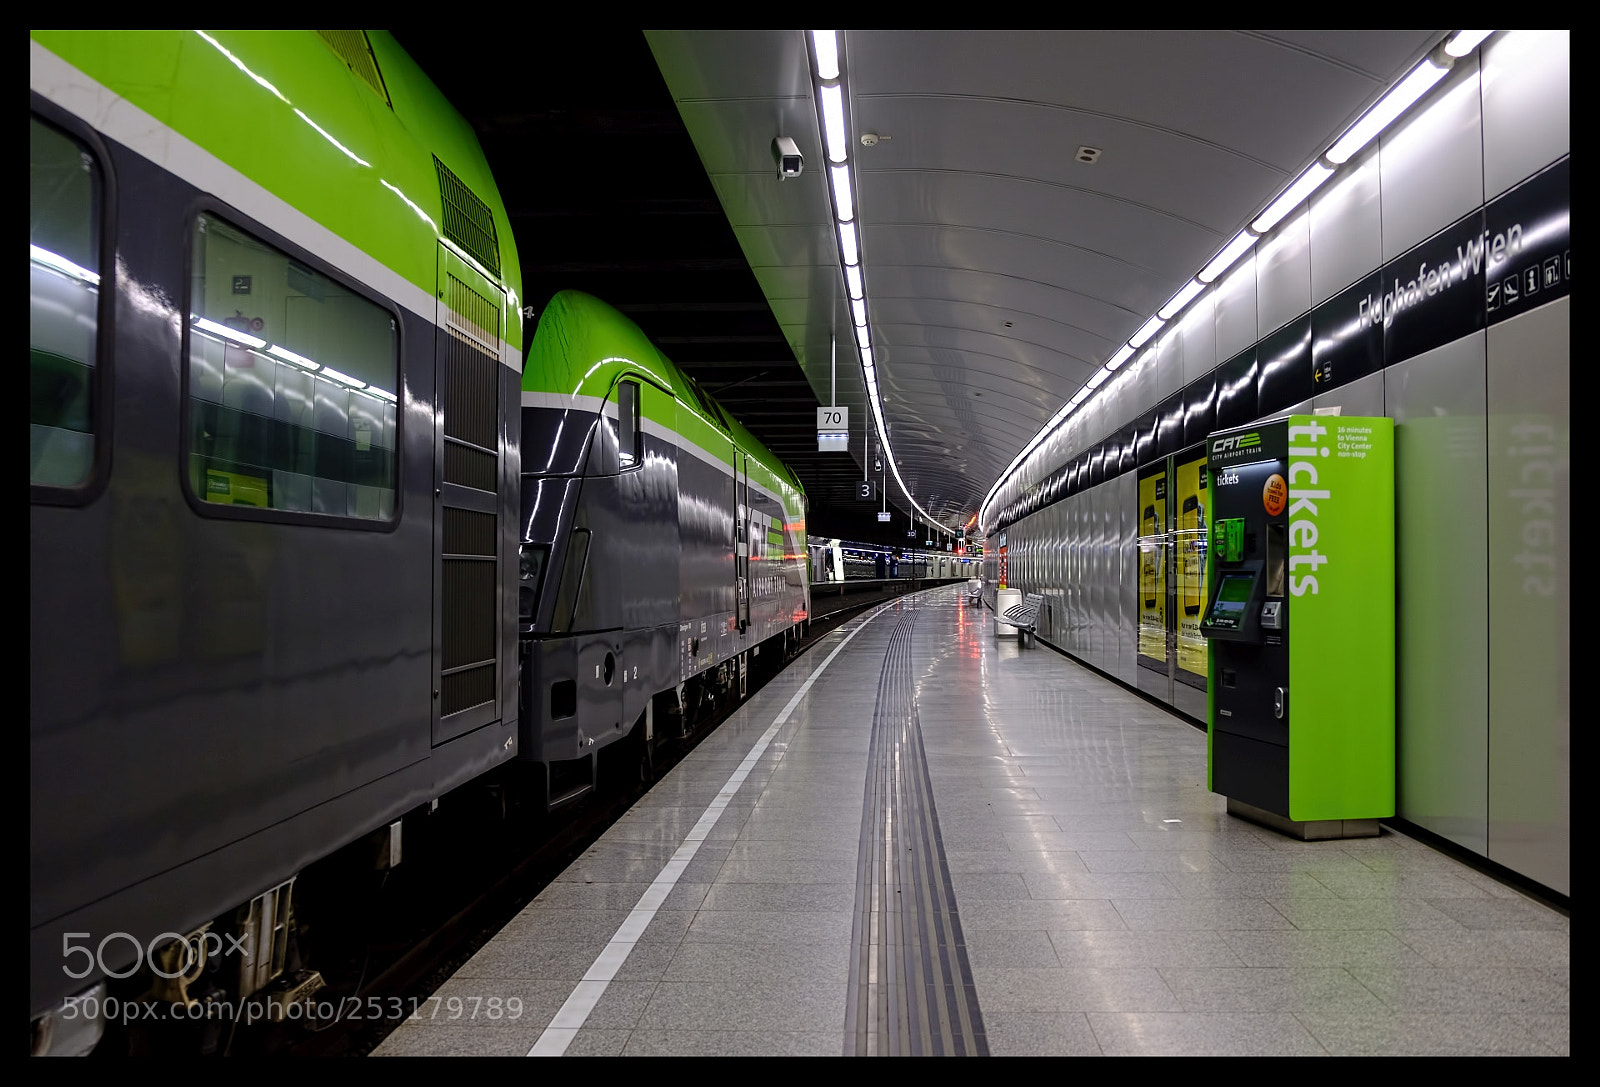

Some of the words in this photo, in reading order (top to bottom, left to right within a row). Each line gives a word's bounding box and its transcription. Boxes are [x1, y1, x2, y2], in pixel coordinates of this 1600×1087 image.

[1358, 262, 1451, 329] Flughafen
[1457, 223, 1523, 280] Wien
[824, 412, 841, 424] 70
[1213, 434, 1246, 453] CAT
[1337, 442, 1350, 451] City
[1224, 450, 1244, 459] AIRPORT
[1246, 447, 1262, 455] TRAIN
[1338, 451, 1366, 459] non-stop
[1217, 474, 1239, 486] tickets
[861, 485, 870, 497] 3
[1289, 421, 1330, 597] tickets
[633, 666, 638, 680] 2
